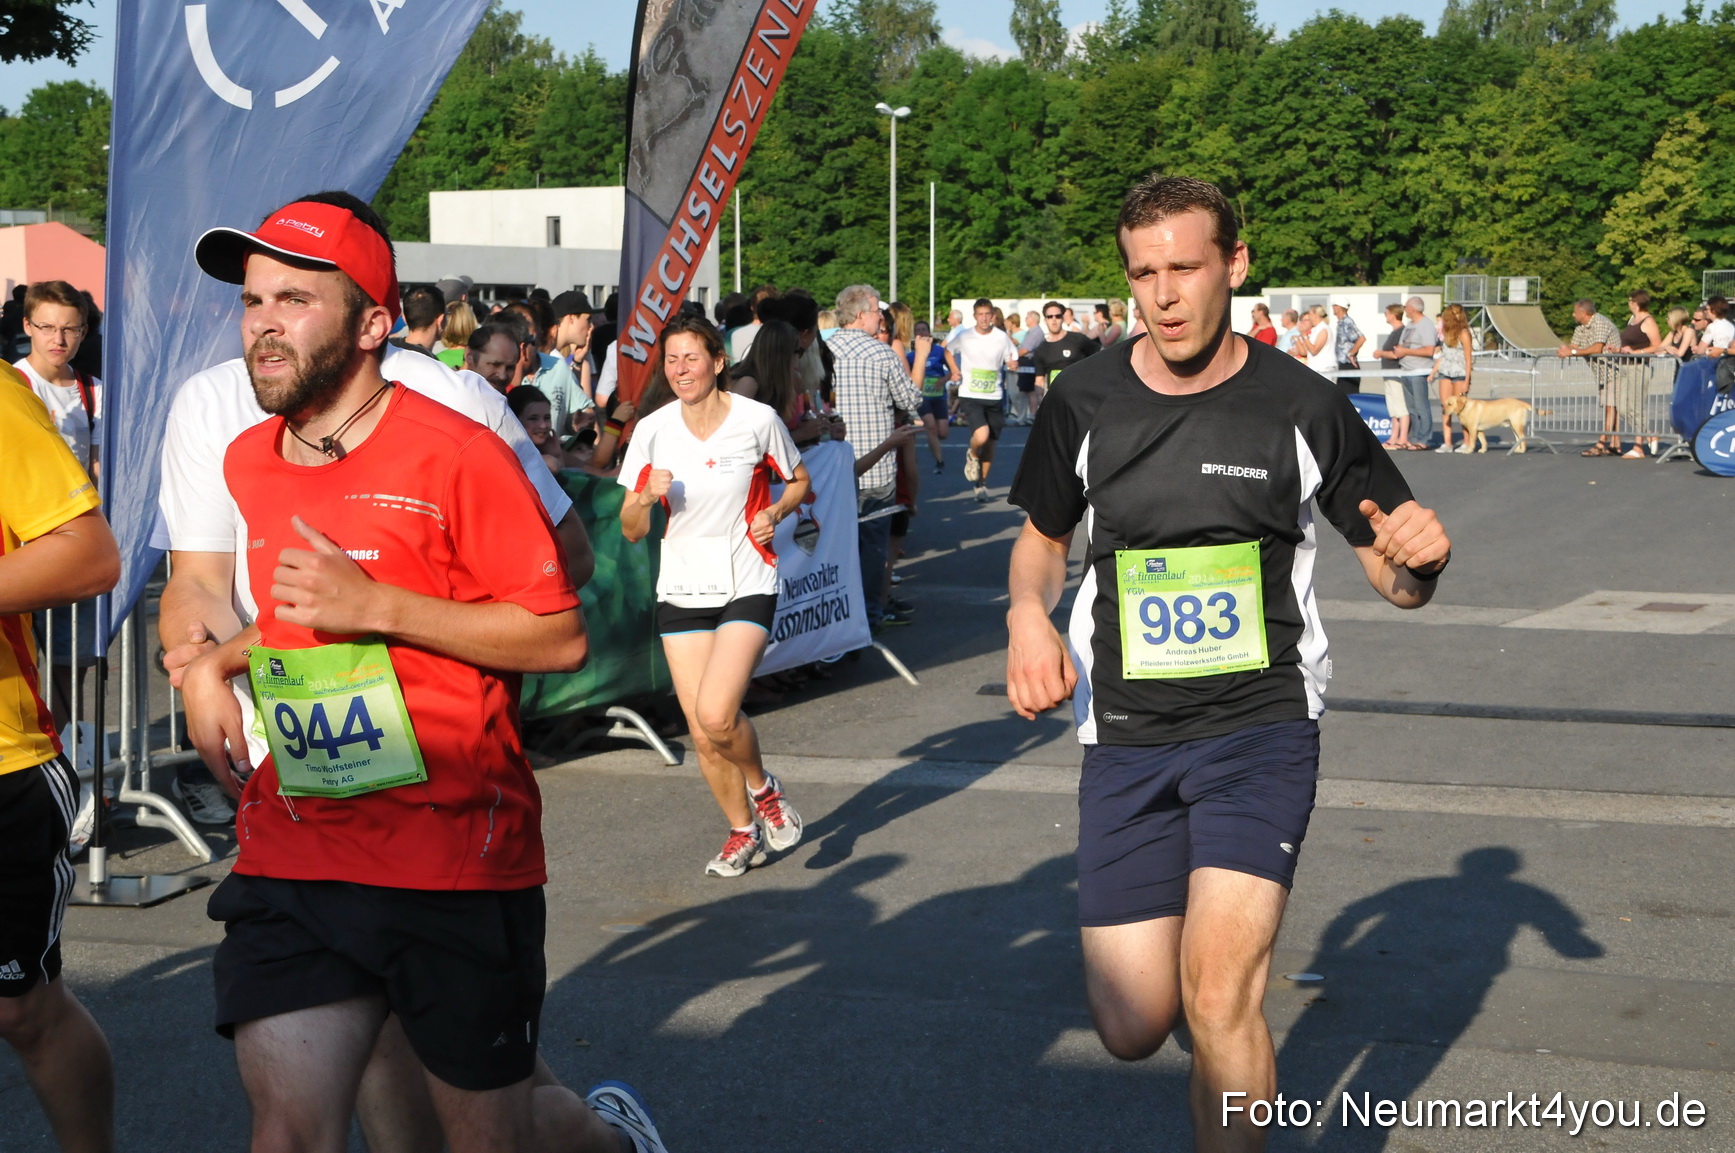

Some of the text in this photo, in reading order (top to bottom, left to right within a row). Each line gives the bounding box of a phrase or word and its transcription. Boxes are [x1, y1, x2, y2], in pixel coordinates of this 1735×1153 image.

[285, 218, 325, 238] Petry
[971, 379, 994, 390] 5097
[1212, 463, 1268, 480] PFLEIDERER
[783, 563, 839, 602] Neumarkter
[1138, 570, 1215, 584] firmenlauf 2014
[768, 587, 850, 644] ammsbräu
[1139, 591, 1241, 645] 983
[1198, 645, 1222, 654] Huber
[1174, 655, 1226, 666] Holzwerkstoffe
[1227, 652, 1250, 660] GmbH
[265, 675, 337, 691] firmenlauf 2014
[274, 695, 385, 760] 944
[305, 758, 371, 773] Timo Wolfsteiner
[322, 774, 355, 787] Petry AG
